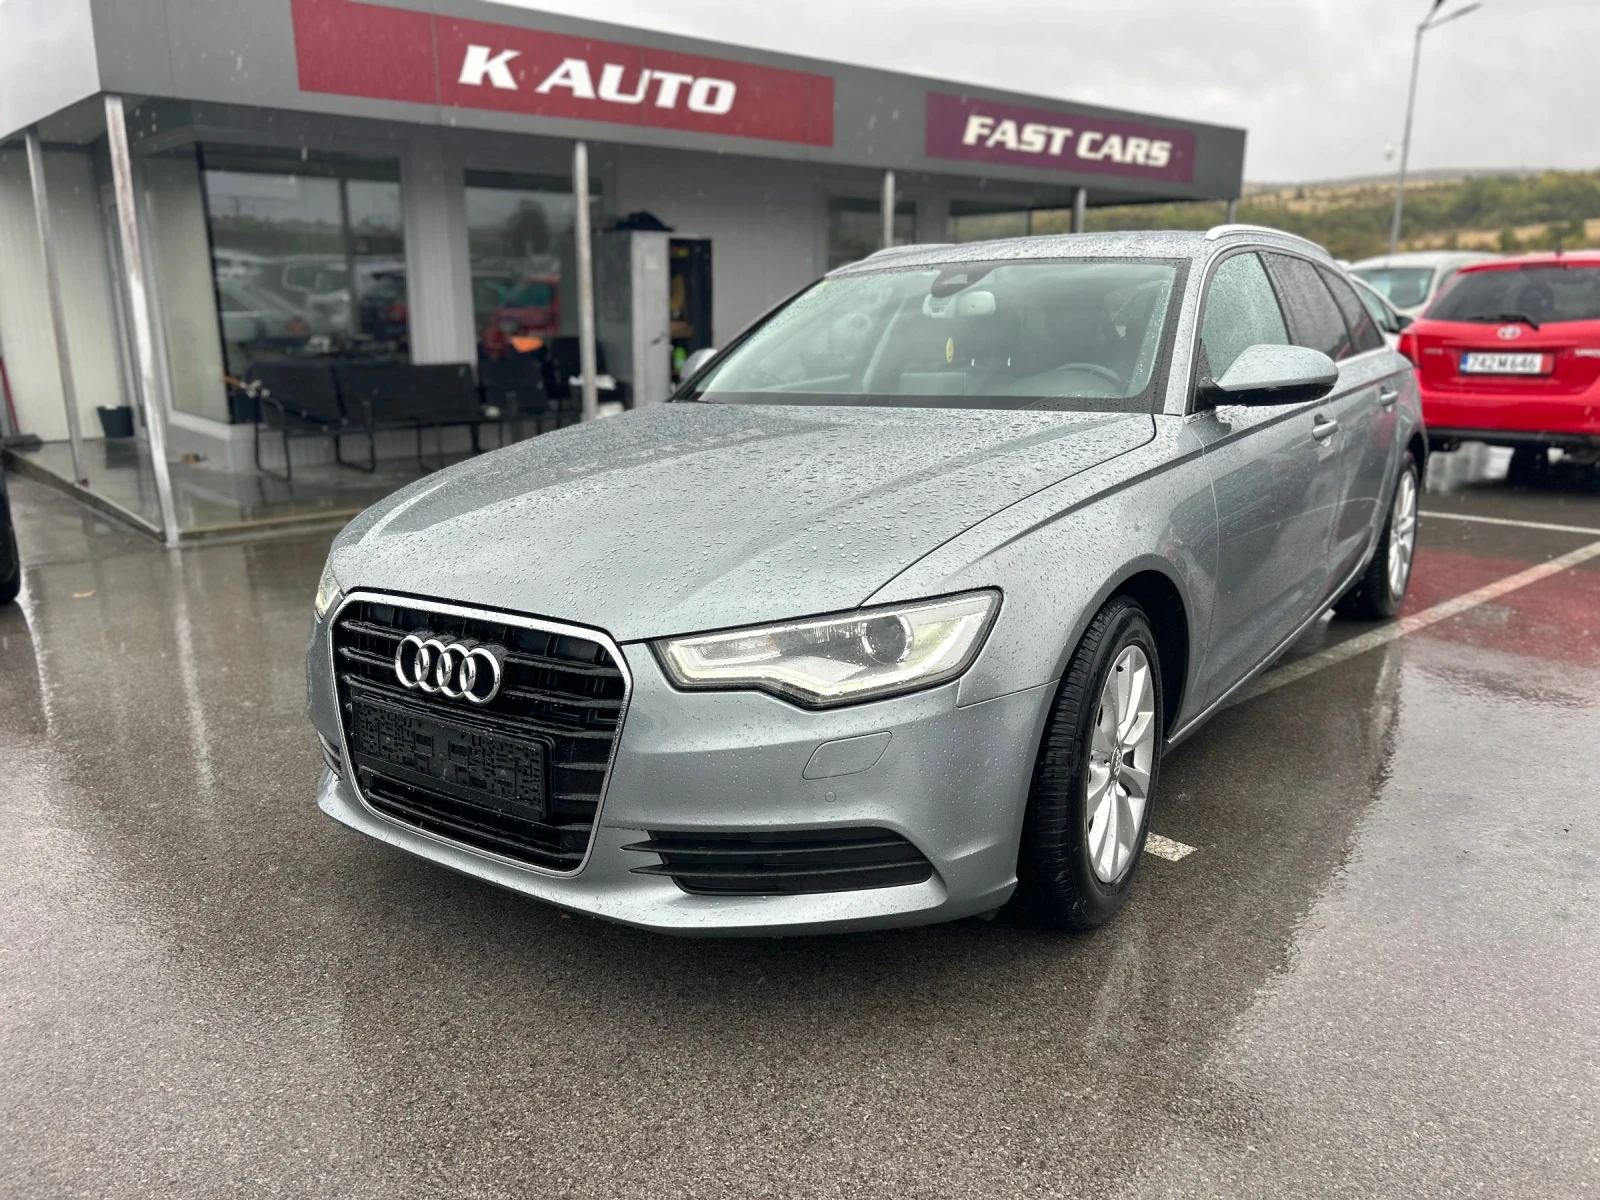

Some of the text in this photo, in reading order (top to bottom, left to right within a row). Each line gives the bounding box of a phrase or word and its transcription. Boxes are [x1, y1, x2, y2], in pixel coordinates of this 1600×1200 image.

[458, 44, 737, 115] K AUTO
[962, 114, 1172, 168] FAST CARS
